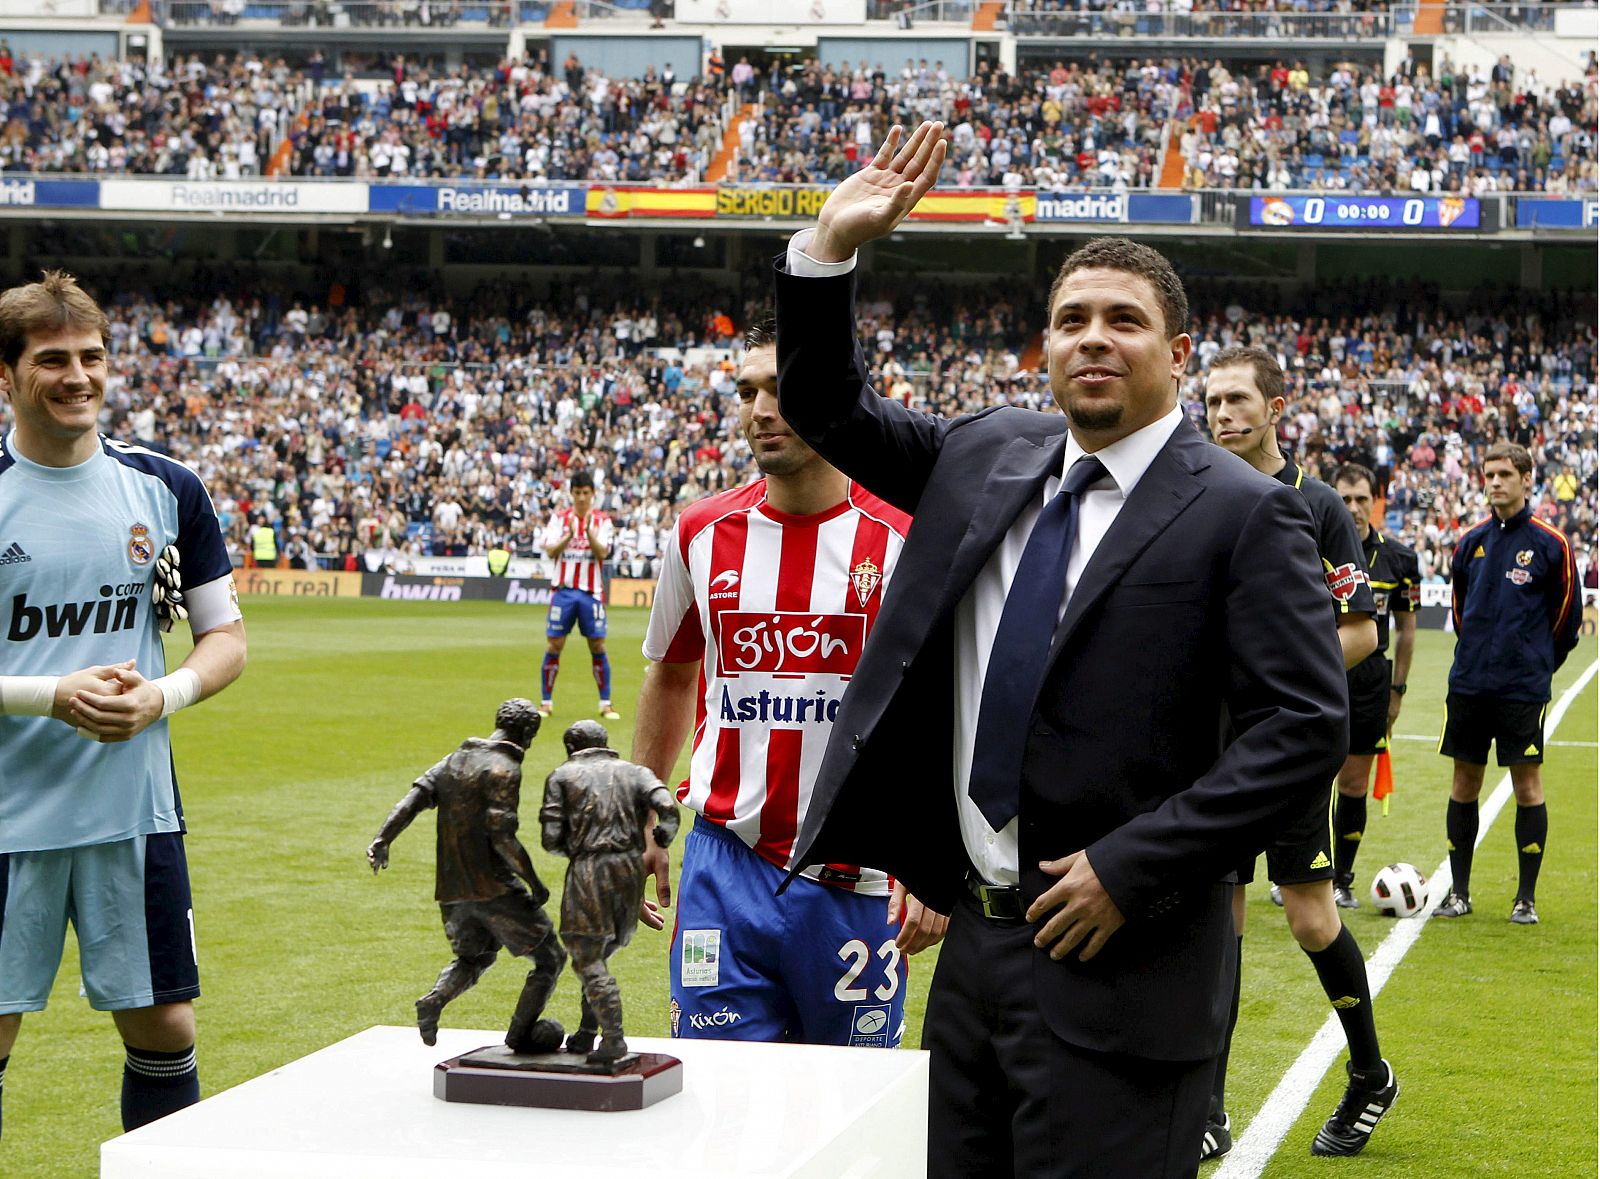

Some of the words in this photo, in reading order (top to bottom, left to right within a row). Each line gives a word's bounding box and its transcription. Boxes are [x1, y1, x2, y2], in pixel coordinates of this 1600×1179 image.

[172, 184, 298, 206] Realmadrid
[437, 187, 569, 213] Realmadrid
[718, 189, 792, 215] SERGIO
[797, 189, 832, 215] RA
[1304, 198, 1325, 224] 0
[1337, 204, 1390, 219] 00:00
[1403, 199, 1424, 225] 0
[248, 574, 282, 595] for
[293, 576, 338, 597] real
[709, 591, 738, 600] ASTORE
[7, 585, 139, 642] bwin
[732, 615, 849, 672] gijón
[187, 909, 197, 965] 1
[834, 939, 901, 1002] 23
